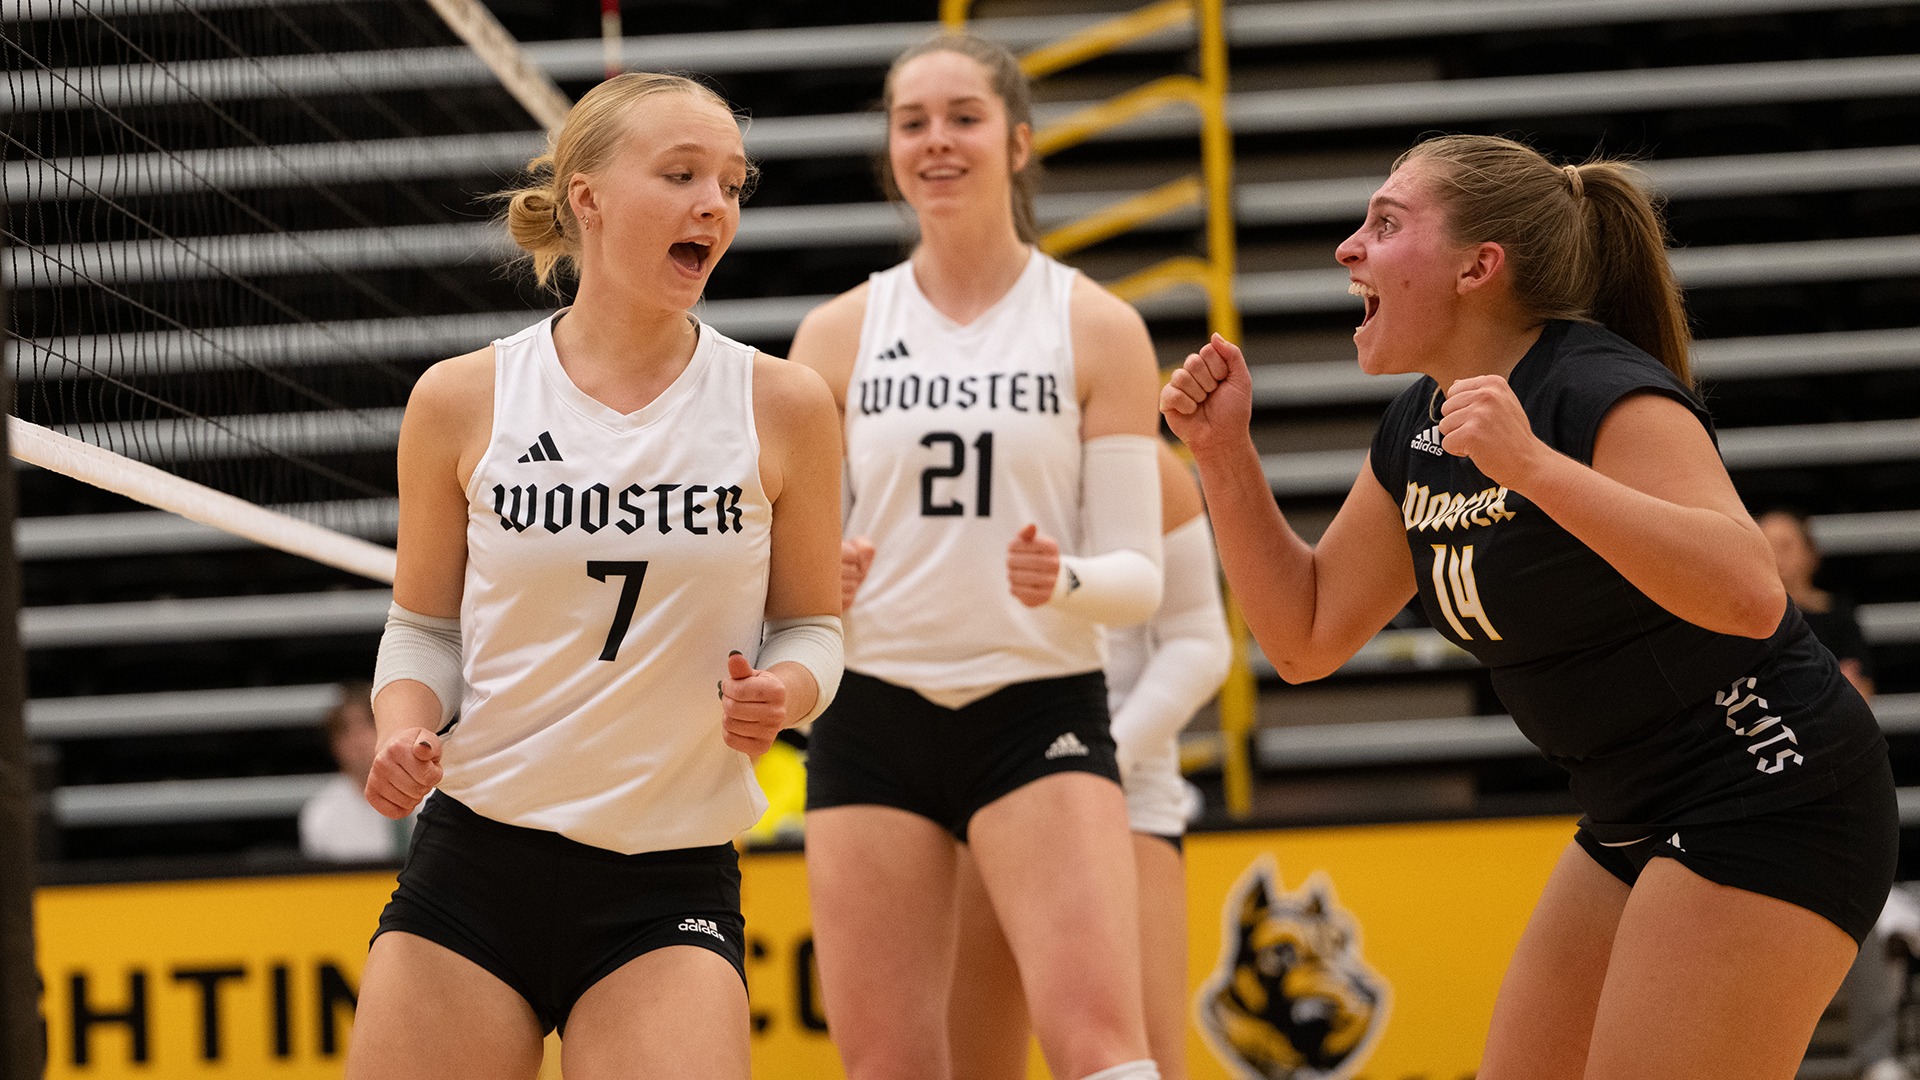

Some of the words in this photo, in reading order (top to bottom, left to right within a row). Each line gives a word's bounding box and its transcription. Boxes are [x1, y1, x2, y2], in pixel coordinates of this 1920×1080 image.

[858, 372, 1061, 417] WOOSTER
[492, 482, 744, 536] WOOSTER
[918, 430, 994, 518] 21
[586, 560, 649, 662] 7
[1430, 543, 1503, 641] 14
[677, 921, 726, 942] adidas
